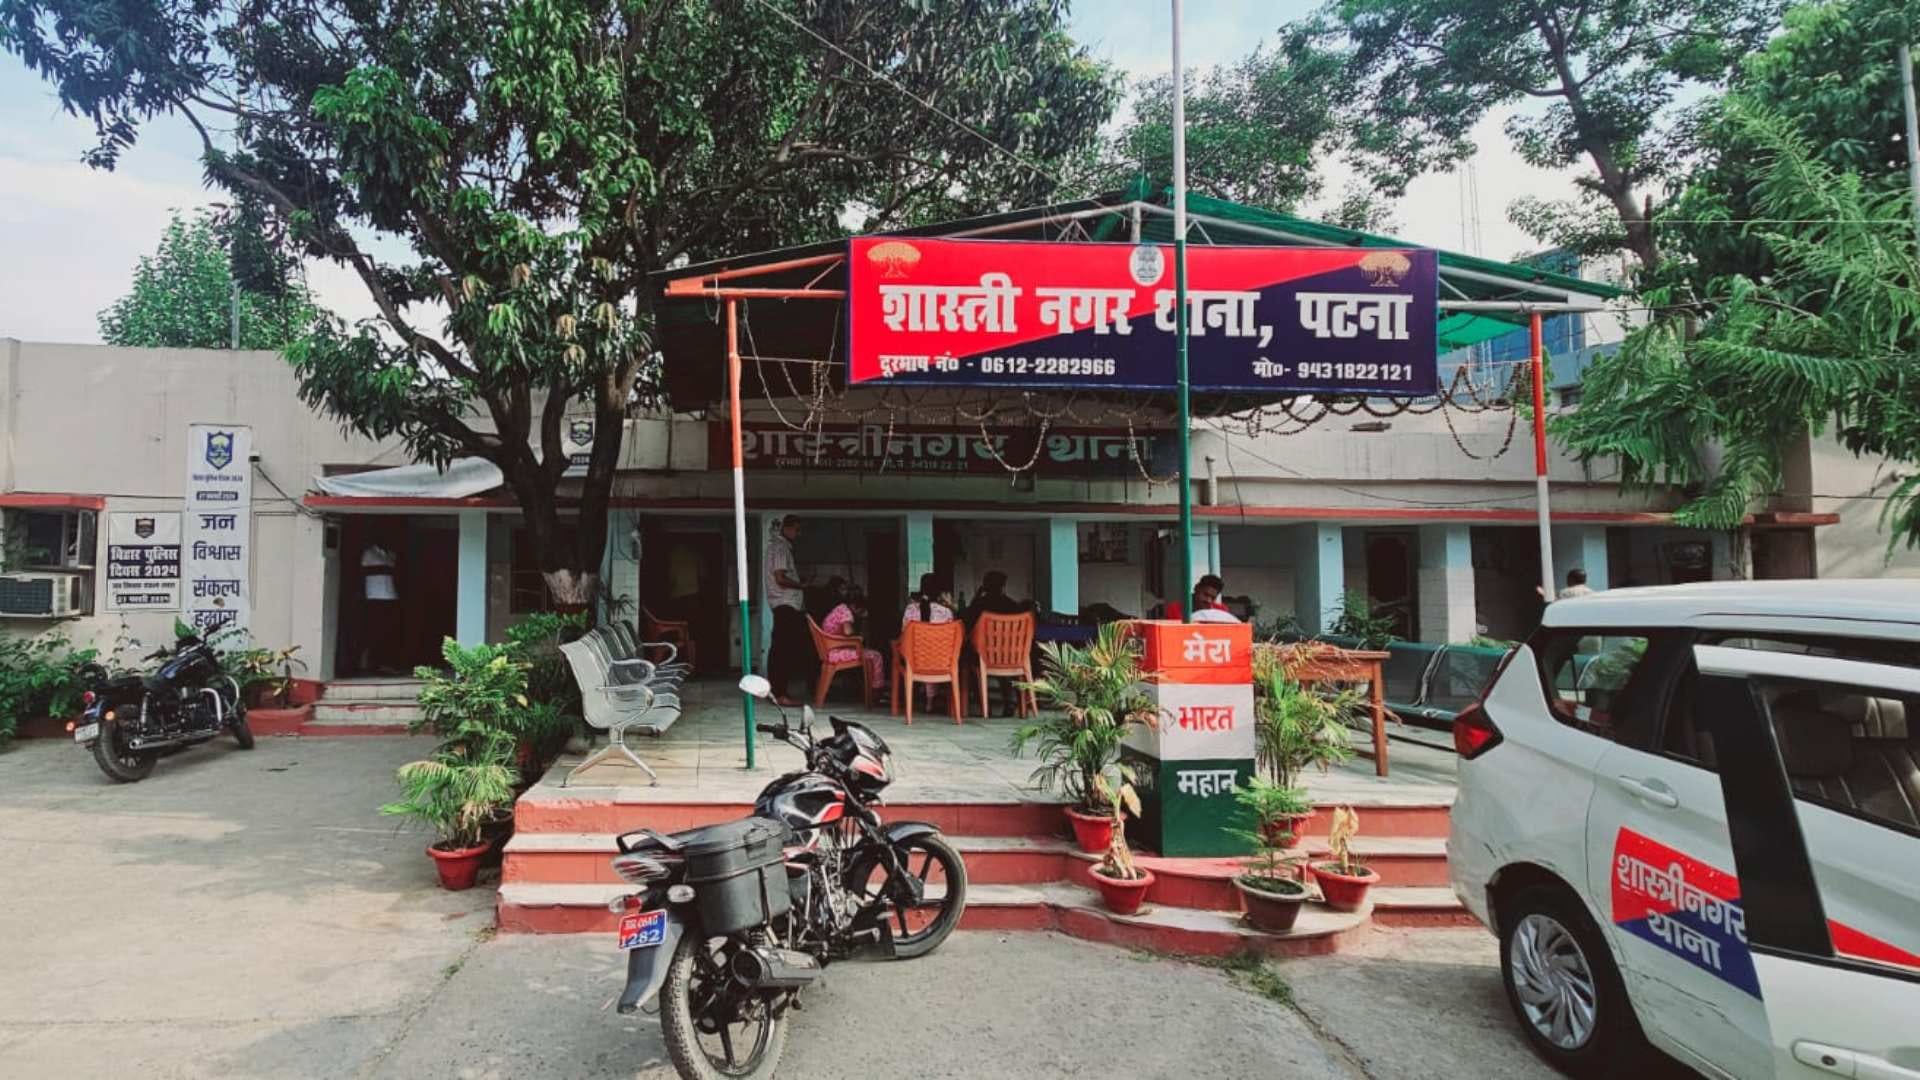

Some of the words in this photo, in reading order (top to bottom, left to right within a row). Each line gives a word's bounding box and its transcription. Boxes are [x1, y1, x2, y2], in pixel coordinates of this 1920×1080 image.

[879, 272, 1022, 333] शास्त्री
[1035, 287, 1135, 335] नगर
[1154, 289, 1274, 348] थाना,
[1295, 292, 1413, 340] पटना
[981, 357, 1116, 376] 0612-2282966
[1298, 362, 1412, 381] 9431822121
[1046, 435, 1158, 463] थाना
[198, 513, 238, 530] जन
[192, 540, 241, 560] विश्वास
[144, 565, 178, 577] 2024
[192, 574, 240, 597] संकल्प
[1183, 633, 1231, 664] मेरा
[1178, 705, 1234, 733] भारत
[1176, 769, 1238, 797] महान
[1617, 853, 1747, 943] शास्त्रीनगर
[1646, 907, 1722, 970] थाना
